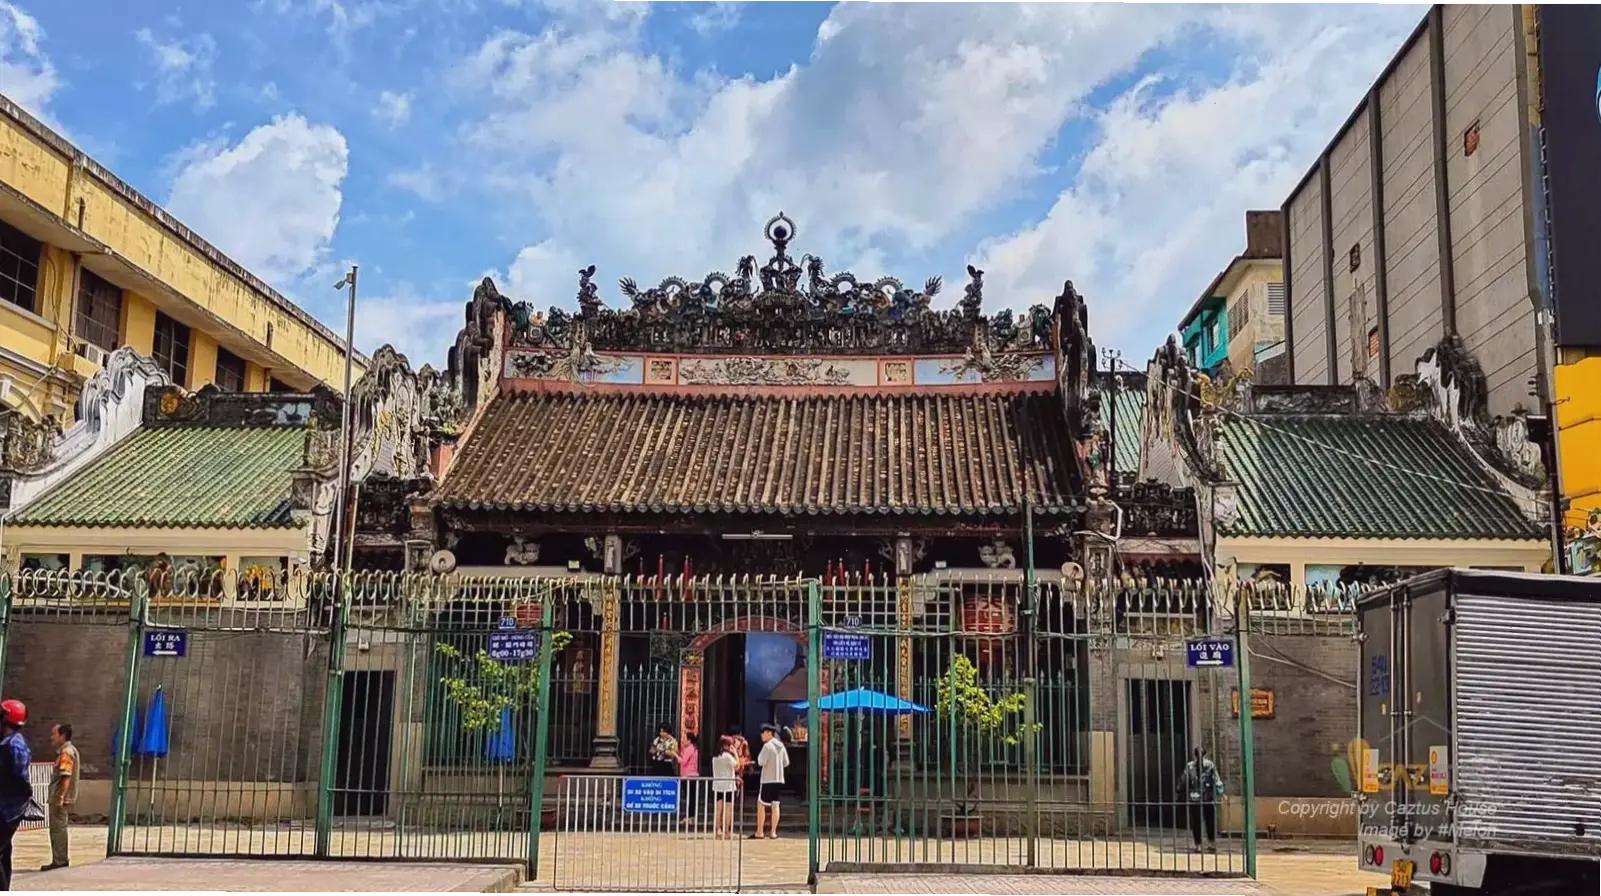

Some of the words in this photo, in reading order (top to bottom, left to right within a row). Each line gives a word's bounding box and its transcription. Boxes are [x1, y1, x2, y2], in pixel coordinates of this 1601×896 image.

[500, 617, 514, 626] 710
[847, 617, 860, 626] 710
[150, 632, 166, 641] LỐI
[1190, 640, 1207, 651] LỐI
[1209, 642, 1230, 651] VÀO
